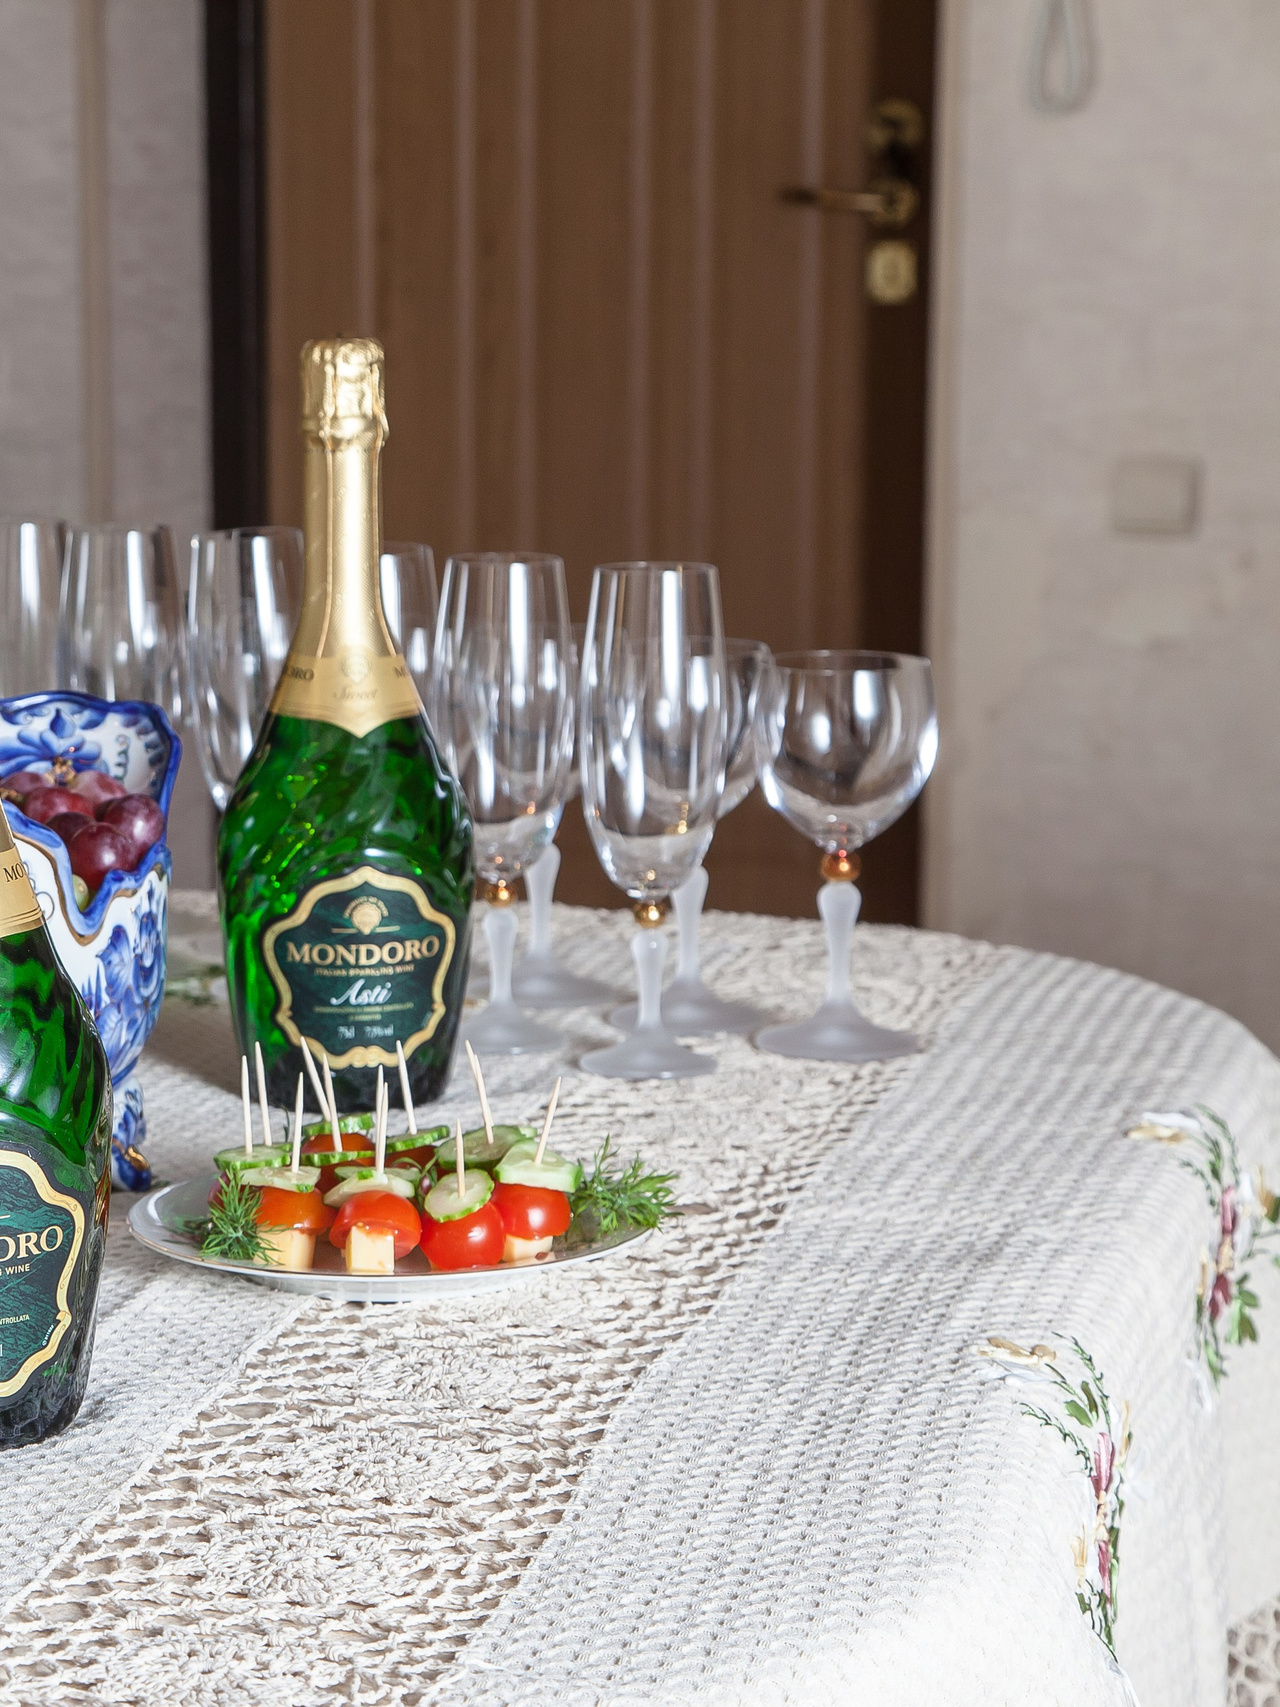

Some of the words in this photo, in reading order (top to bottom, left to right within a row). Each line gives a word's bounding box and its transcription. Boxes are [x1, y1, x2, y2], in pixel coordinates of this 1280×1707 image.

[285, 934, 440, 966] MONDORO
[329, 978, 393, 1006] Asti
[5, 1263, 30, 1274] WINE
